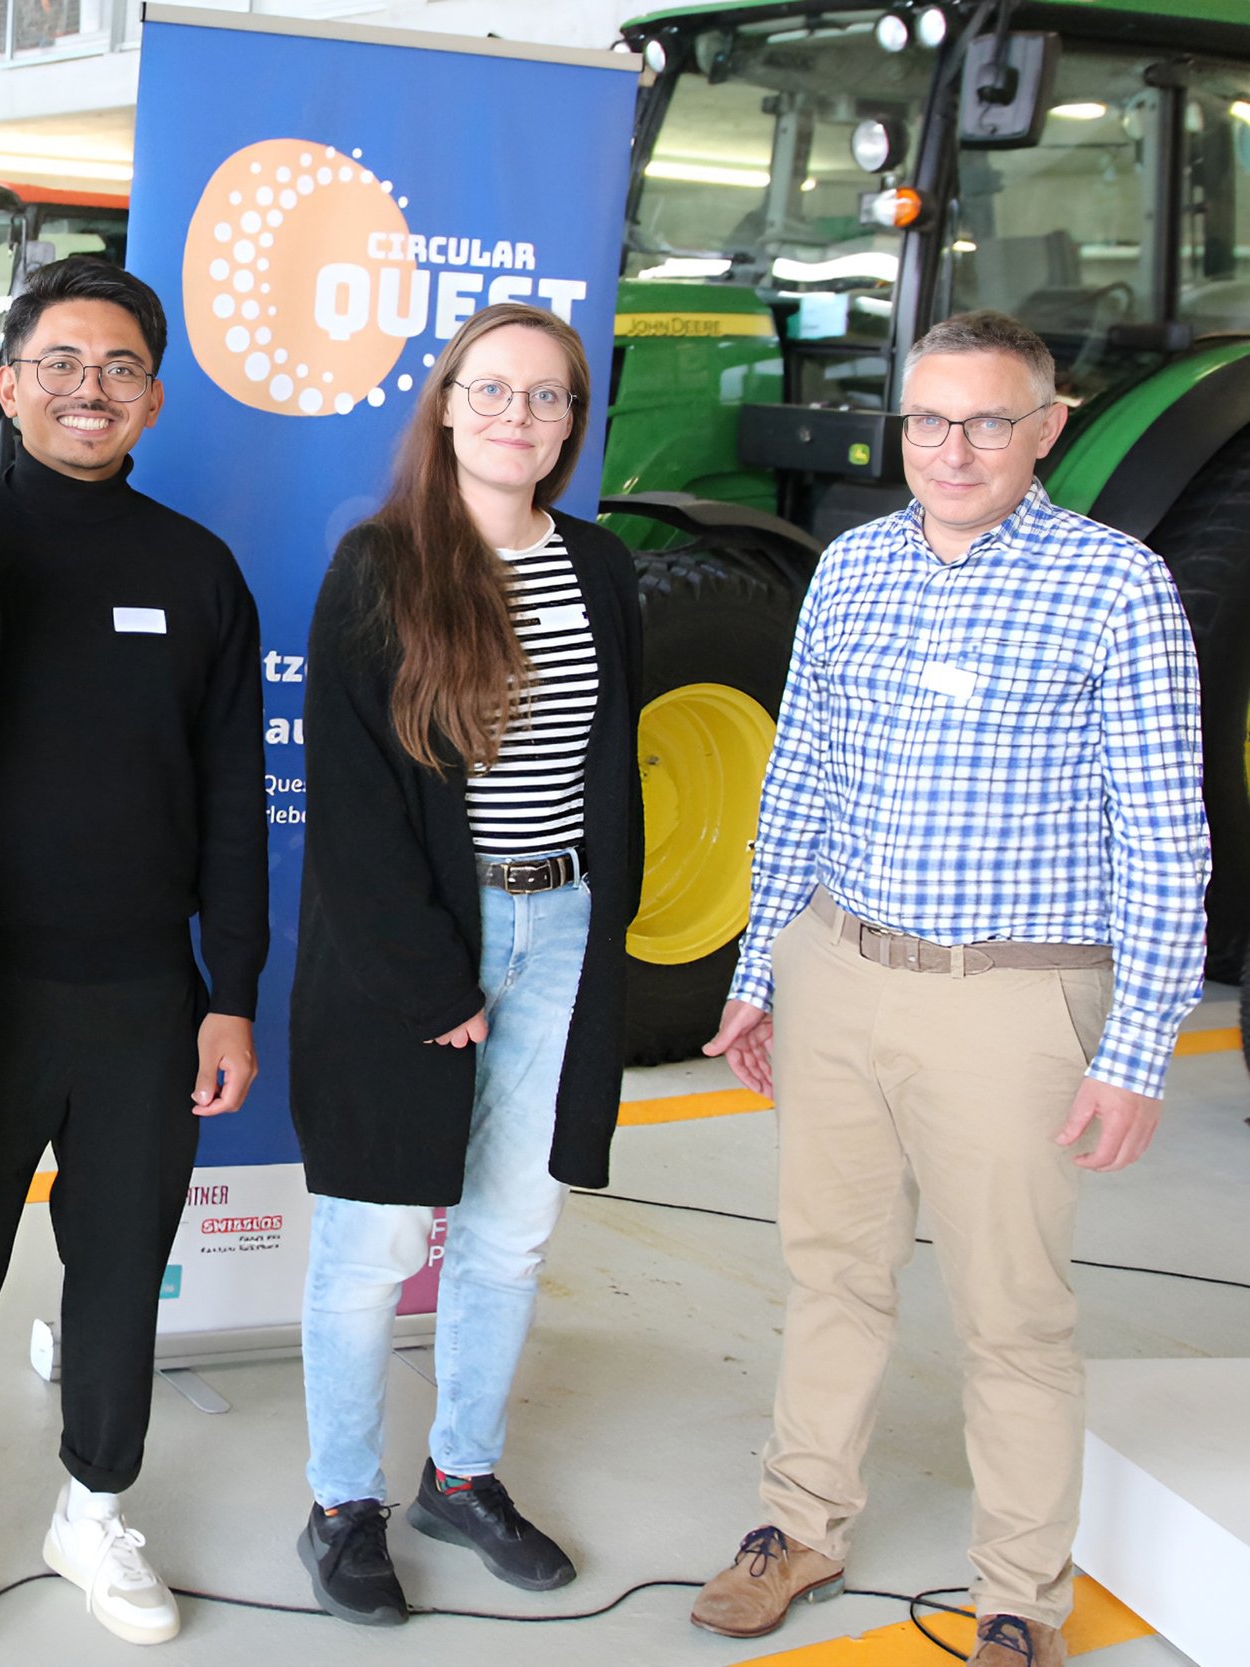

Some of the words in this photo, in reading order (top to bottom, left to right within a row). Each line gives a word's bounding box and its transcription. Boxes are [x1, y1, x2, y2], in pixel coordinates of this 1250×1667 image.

[367, 231, 536, 270] CIRCULAR
[263, 650, 308, 682] tz
[264, 774, 306, 796] Que
